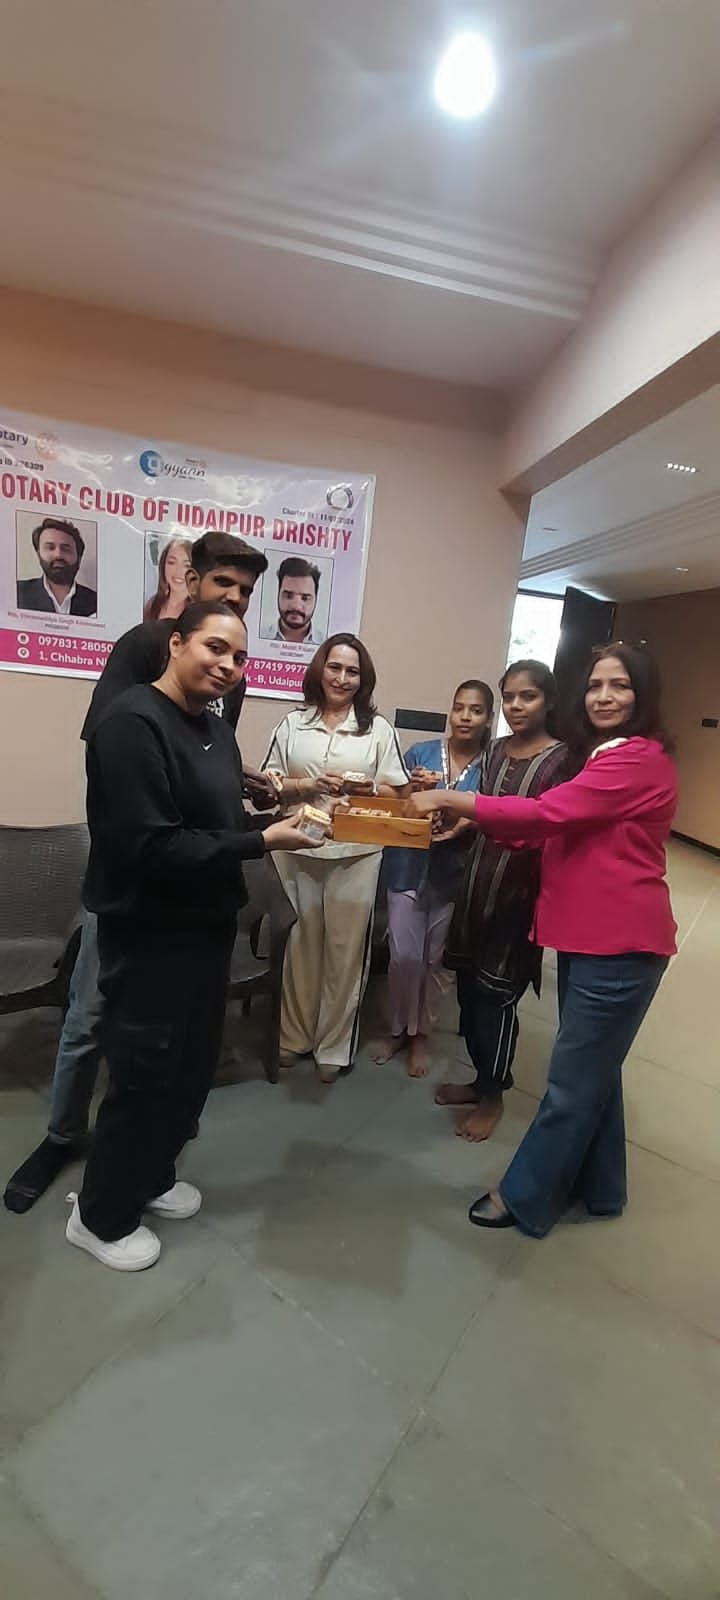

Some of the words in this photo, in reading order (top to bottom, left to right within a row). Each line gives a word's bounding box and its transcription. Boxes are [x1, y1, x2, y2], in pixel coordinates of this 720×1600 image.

[2, 473, 72, 507] OTARY
[79, 486, 135, 517] CLUB
[143, 498, 170, 523] OF
[177, 502, 266, 538] UDAIPUR
[272, 518, 352, 551] DRISHTY
[38, 635, 77, 649] 097831
[81, 641, 113, 653] 28050
[254, 660, 283, 671] 87419
[50, 652, 93, 666] Chhabra
